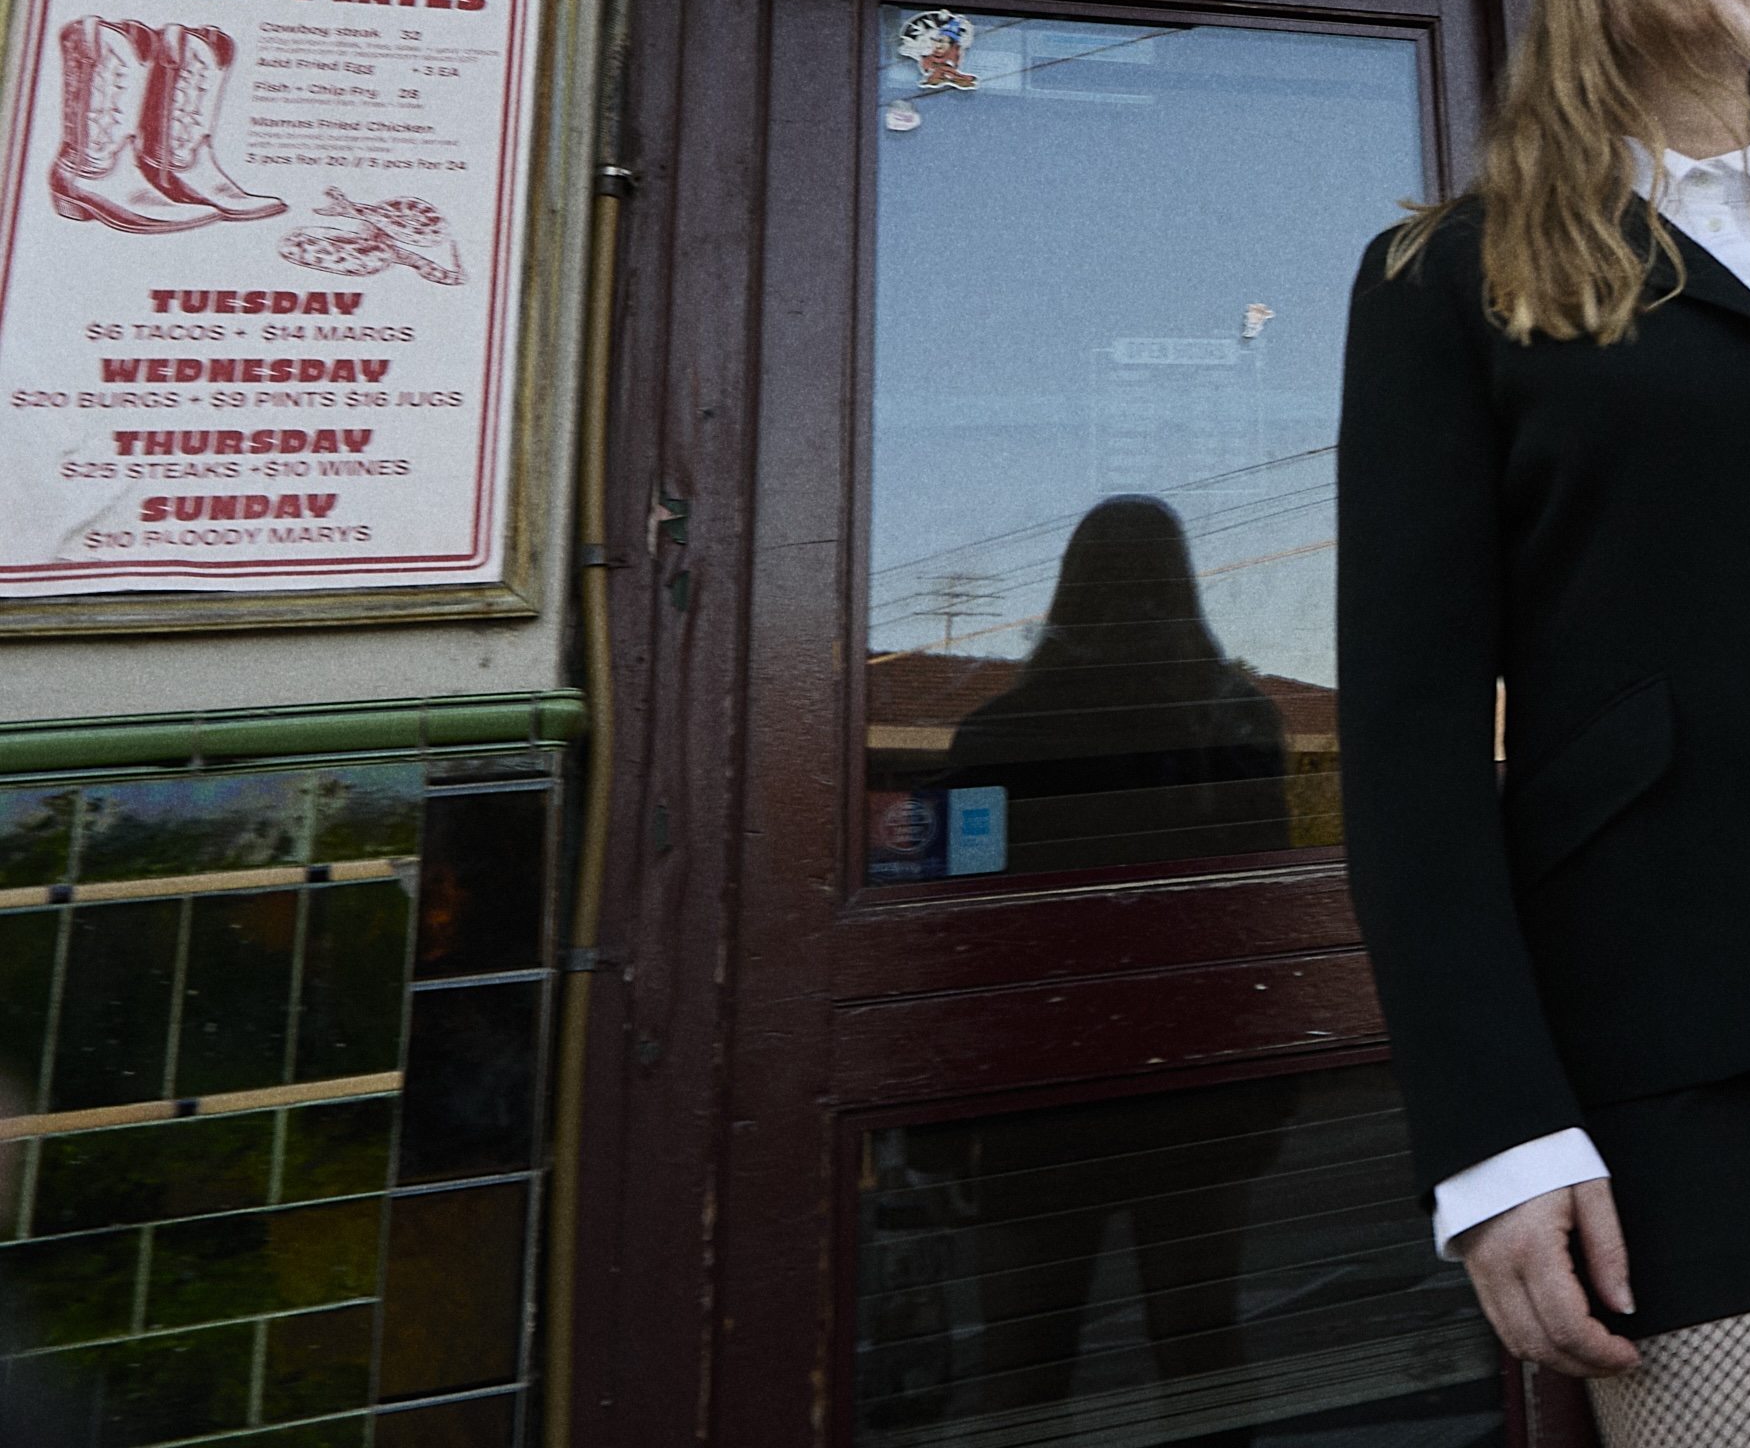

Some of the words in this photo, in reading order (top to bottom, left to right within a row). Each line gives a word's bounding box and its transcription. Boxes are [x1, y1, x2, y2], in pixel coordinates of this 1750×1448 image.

[149, 290, 364, 315] TUESDAY
[85, 321, 124, 341] $6
[131, 323, 226, 341] TACOS
[261, 324, 306, 343] $14
[313, 325, 416, 342] MARGS
[100, 358, 391, 383] WEDNESDAY
[12, 390, 69, 410] $20
[76, 391, 181, 409] BURGS
[210, 390, 247, 410] $9
[253, 391, 337, 408] PINTS
[344, 390, 389, 409] $16
[394, 391, 464, 408] JUGS
[112, 429, 373, 456] THURSDAY
[60, 461, 117, 481] $25
[125, 460, 241, 480] STEAKS
[317, 459, 411, 477] WINES
[139, 493, 338, 522] SUNDAY
[83, 529, 135, 552] $10
[268, 524, 372, 545] MARYS
